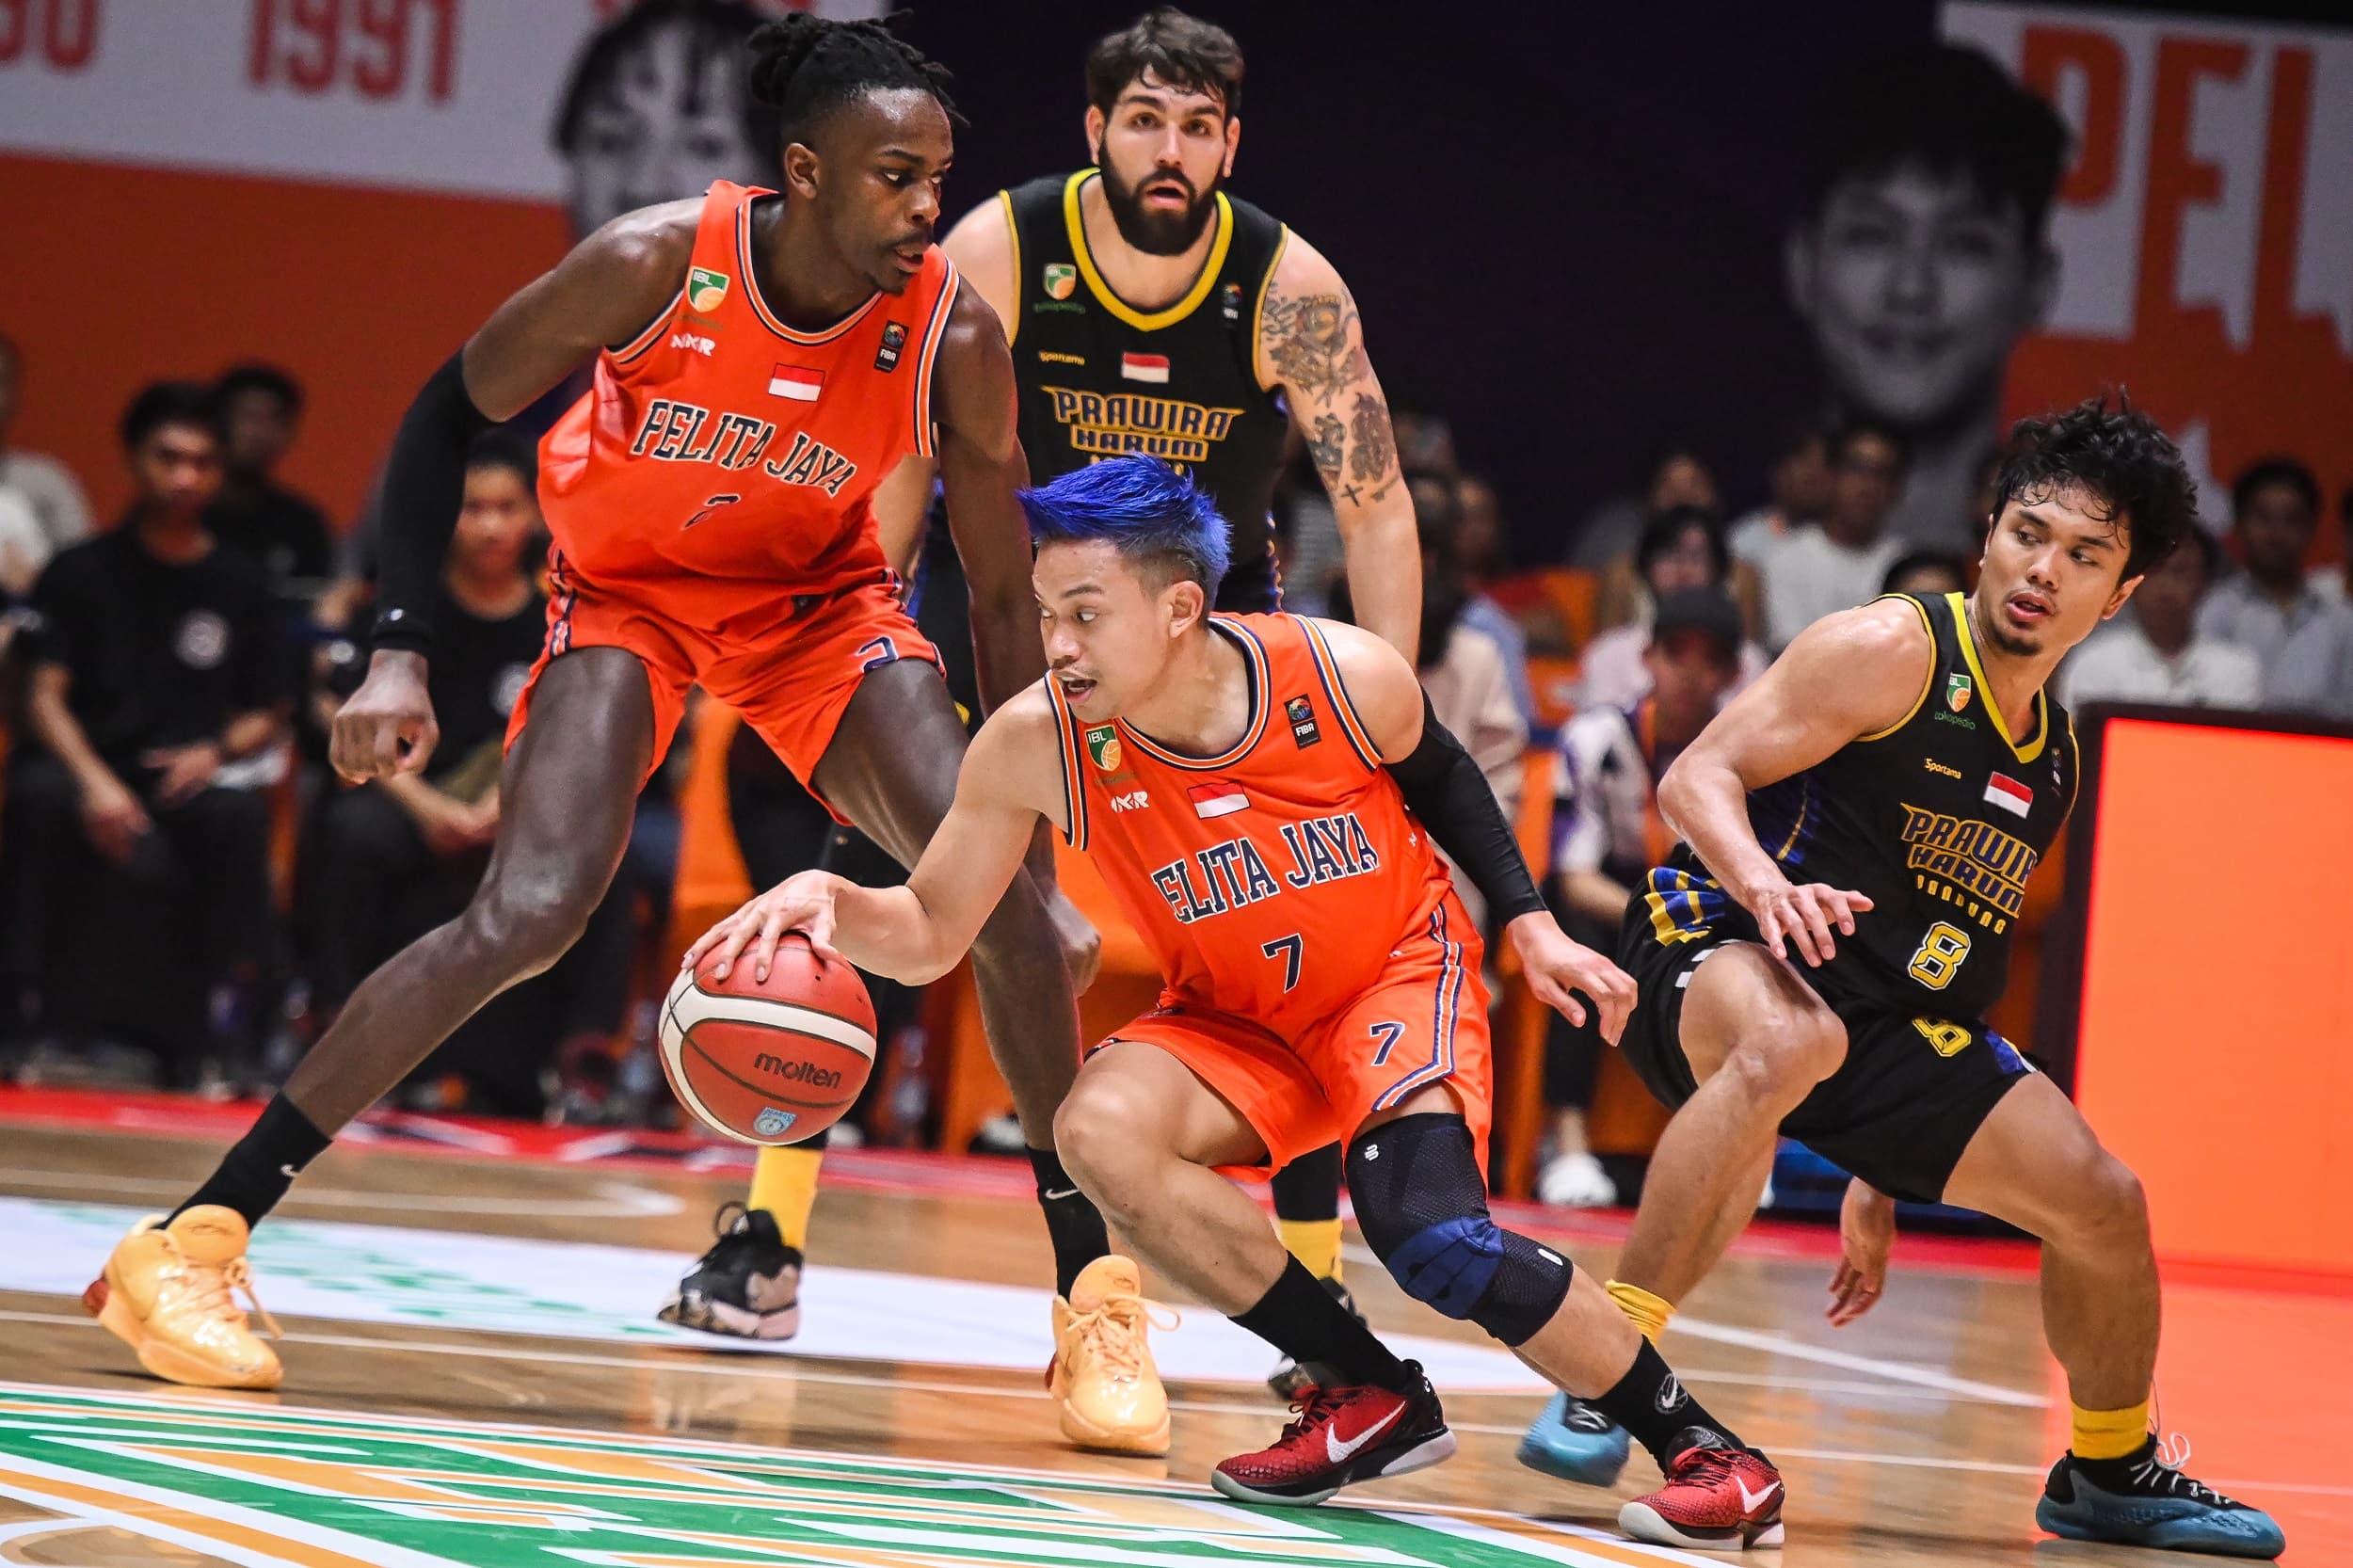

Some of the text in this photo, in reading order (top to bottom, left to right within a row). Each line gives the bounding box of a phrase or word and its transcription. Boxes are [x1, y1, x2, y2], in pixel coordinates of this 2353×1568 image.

[1039, 385, 1246, 441] PRAWIRA
[630, 398, 858, 499] PELITA JAYA
[1069, 424, 1210, 463] HARUM
[1087, 730, 1108, 744] IBL
[1295, 722, 1316, 737] FIBA
[1924, 758, 1963, 780] Sportama
[1280, 812, 1380, 889] JAYA
[1261, 933, 1304, 994] 7
[1908, 920, 1972, 991] 8
[1369, 1021, 1406, 1066] 7
[754, 1052, 842, 1090] molten
